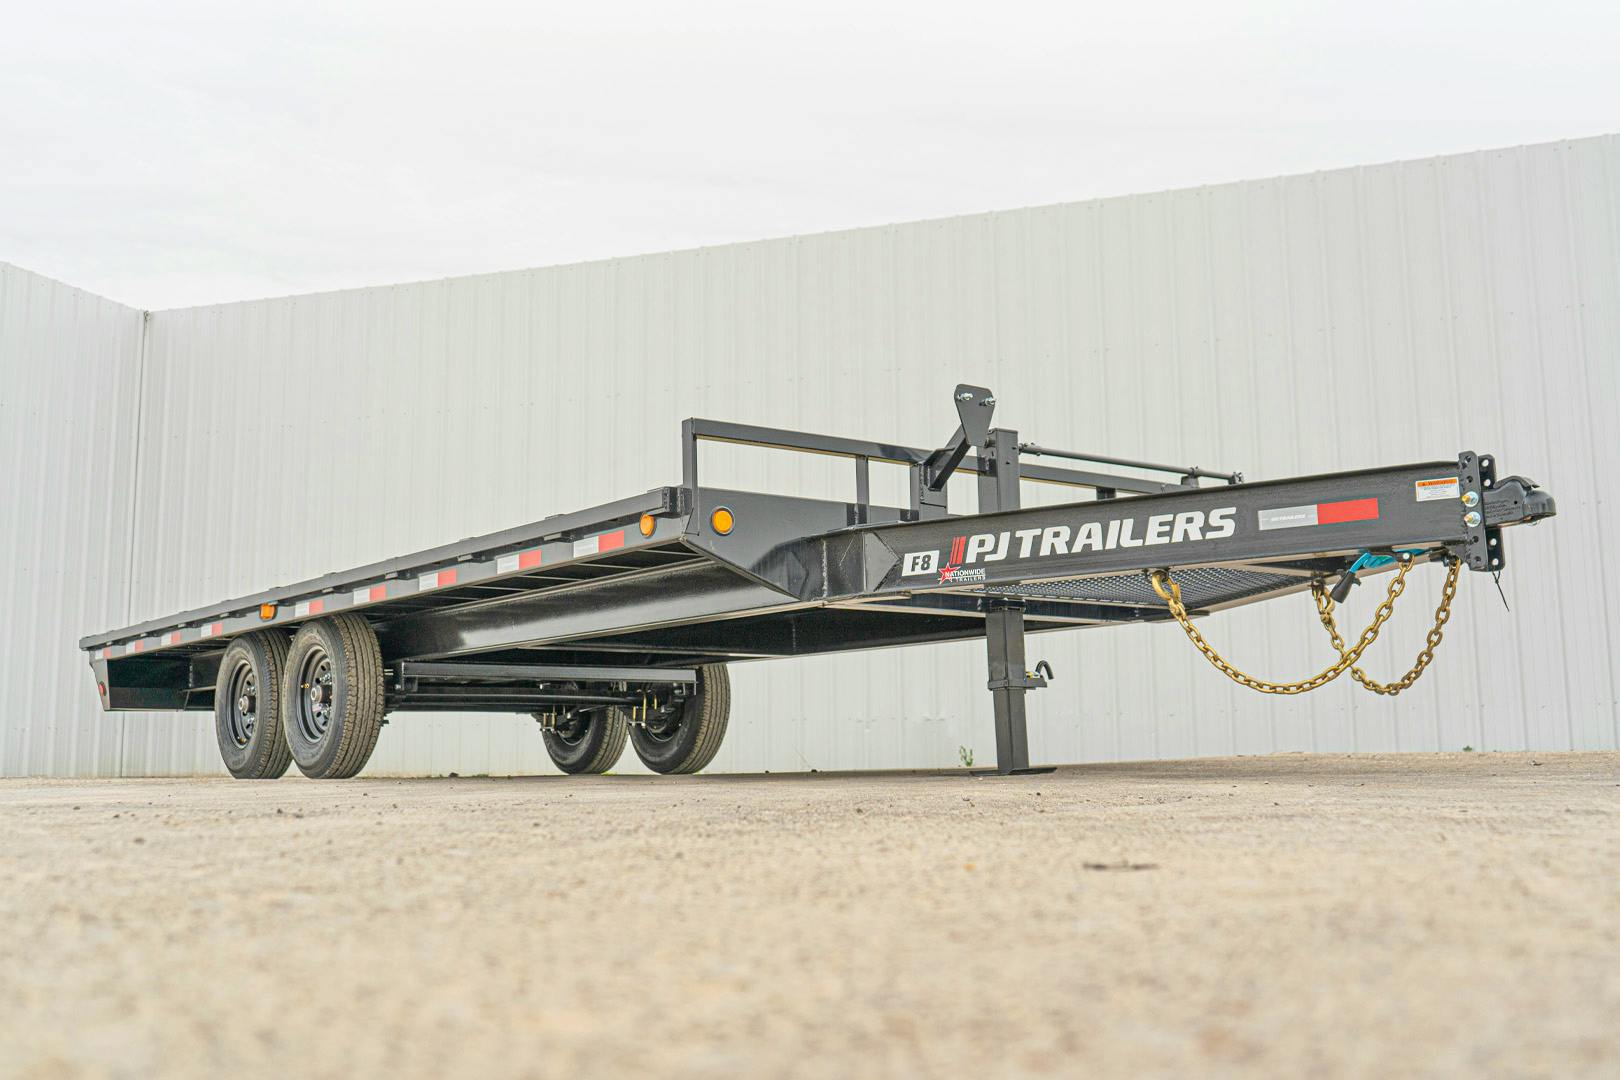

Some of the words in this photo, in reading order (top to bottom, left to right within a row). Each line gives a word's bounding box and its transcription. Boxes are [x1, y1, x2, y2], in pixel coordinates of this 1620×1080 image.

[1015, 507, 1237, 558] TRAILERS
[910, 554, 932, 572] F8
[945, 568, 986, 577] NATIONWIDE
